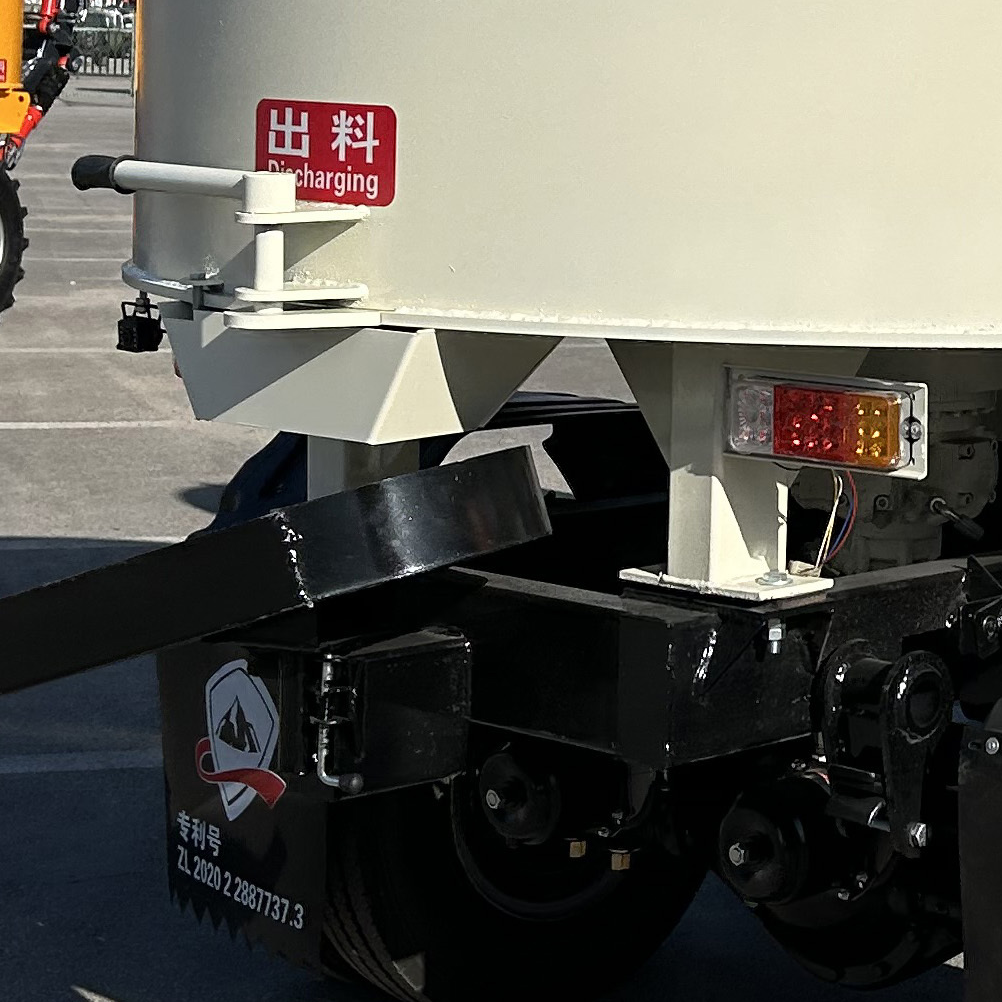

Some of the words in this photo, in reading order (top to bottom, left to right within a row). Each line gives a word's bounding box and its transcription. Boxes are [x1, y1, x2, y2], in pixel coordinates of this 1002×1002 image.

[268, 107, 380, 164] 出料
[176, 809, 222, 857] 专利号
[177, 844, 192, 876] ZL
[193, 855, 221, 891] 2020
[223, 871, 232, 897] 2
[233, 876, 304, 929] 2887737.3
